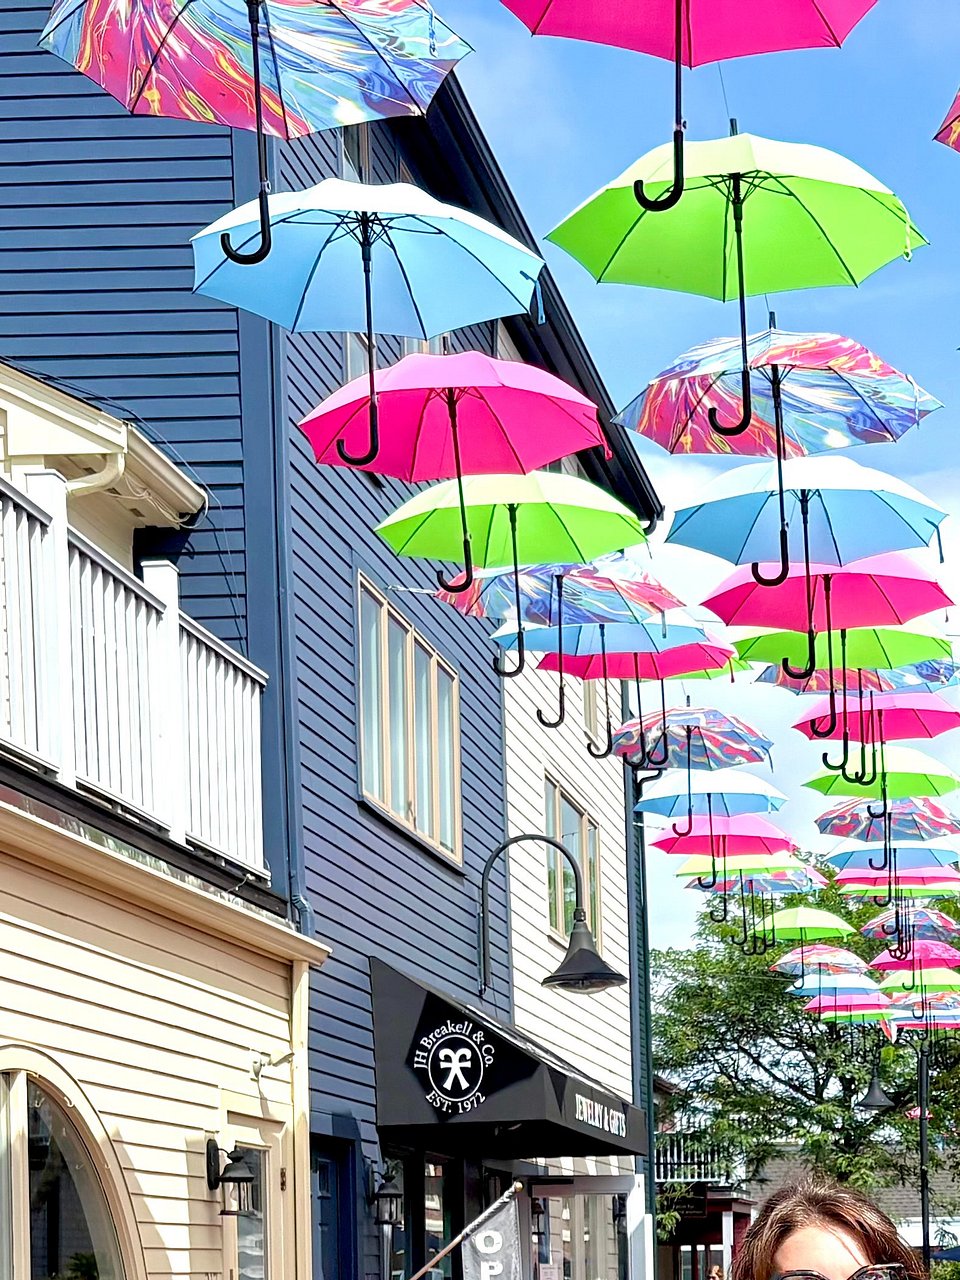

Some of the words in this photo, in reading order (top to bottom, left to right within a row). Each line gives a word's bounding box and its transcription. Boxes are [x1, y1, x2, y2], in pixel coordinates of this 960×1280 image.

[420, 1020, 473, 1049] Breakell
[472, 1031, 485, 1045] &
[414, 1050, 429, 1068] JH
[482, 1044, 495, 1068] Co.
[426, 1090, 452, 1113] EST.
[457, 1092, 486, 1114] 1972
[575, 1093, 603, 1129] JEWELRY
[609, 1109, 626, 1138] GIFTS
